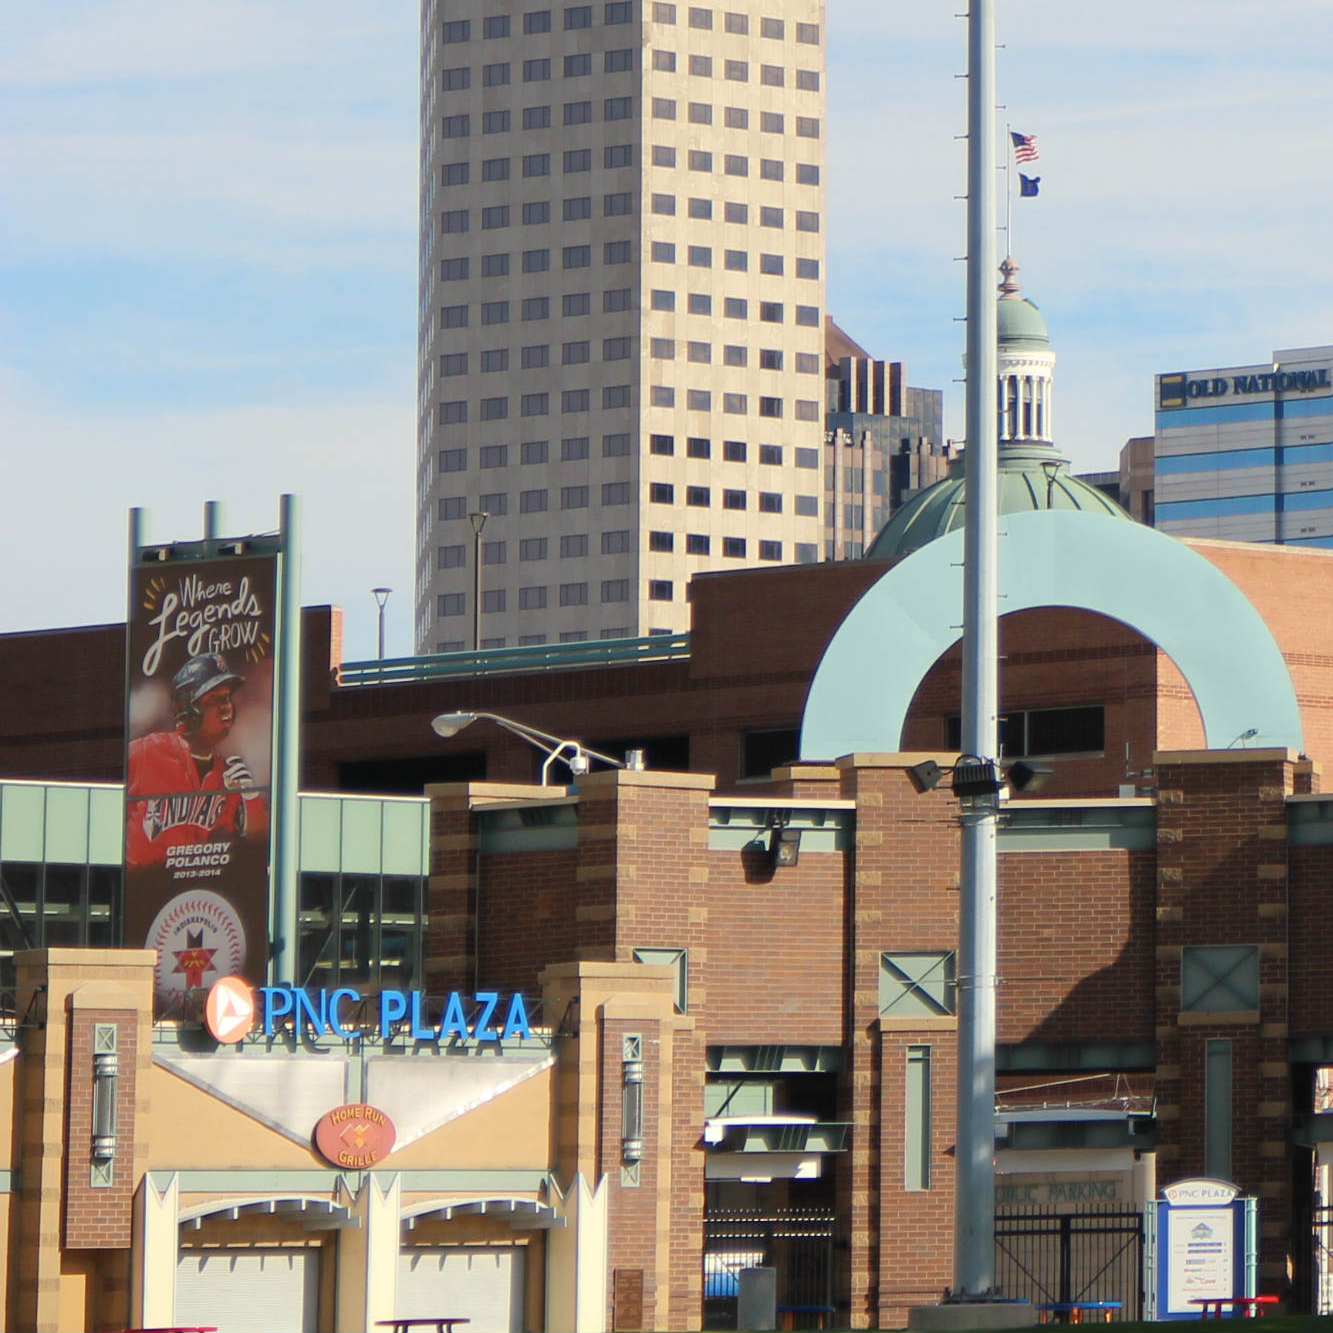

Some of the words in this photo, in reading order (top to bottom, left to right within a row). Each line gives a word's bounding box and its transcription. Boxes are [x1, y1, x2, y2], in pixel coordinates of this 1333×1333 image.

[1186, 378, 1228, 398] OLD
[1232, 369, 1332, 394] NATIONAL
[179, 574, 232, 607] Where
[143, 577, 262, 676] Legends
[208, 621, 258, 654] GROW
[166, 842, 231, 856] GREGORY
[166, 854, 230, 868] POLANCO
[259, 986, 361, 1039] PNC
[379, 990, 531, 1041] PLAZA
[330, 1107, 361, 1126] HOME
[364, 1106, 386, 1127] RUN
[338, 1150, 377, 1167] GRILLE
[995, 1184, 1039, 1203] UBLIC
[1048, 1180, 1116, 1202] PARKING
[1179, 1190, 1198, 1198] PNC
[1201, 1189, 1233, 1198] PLAZA
